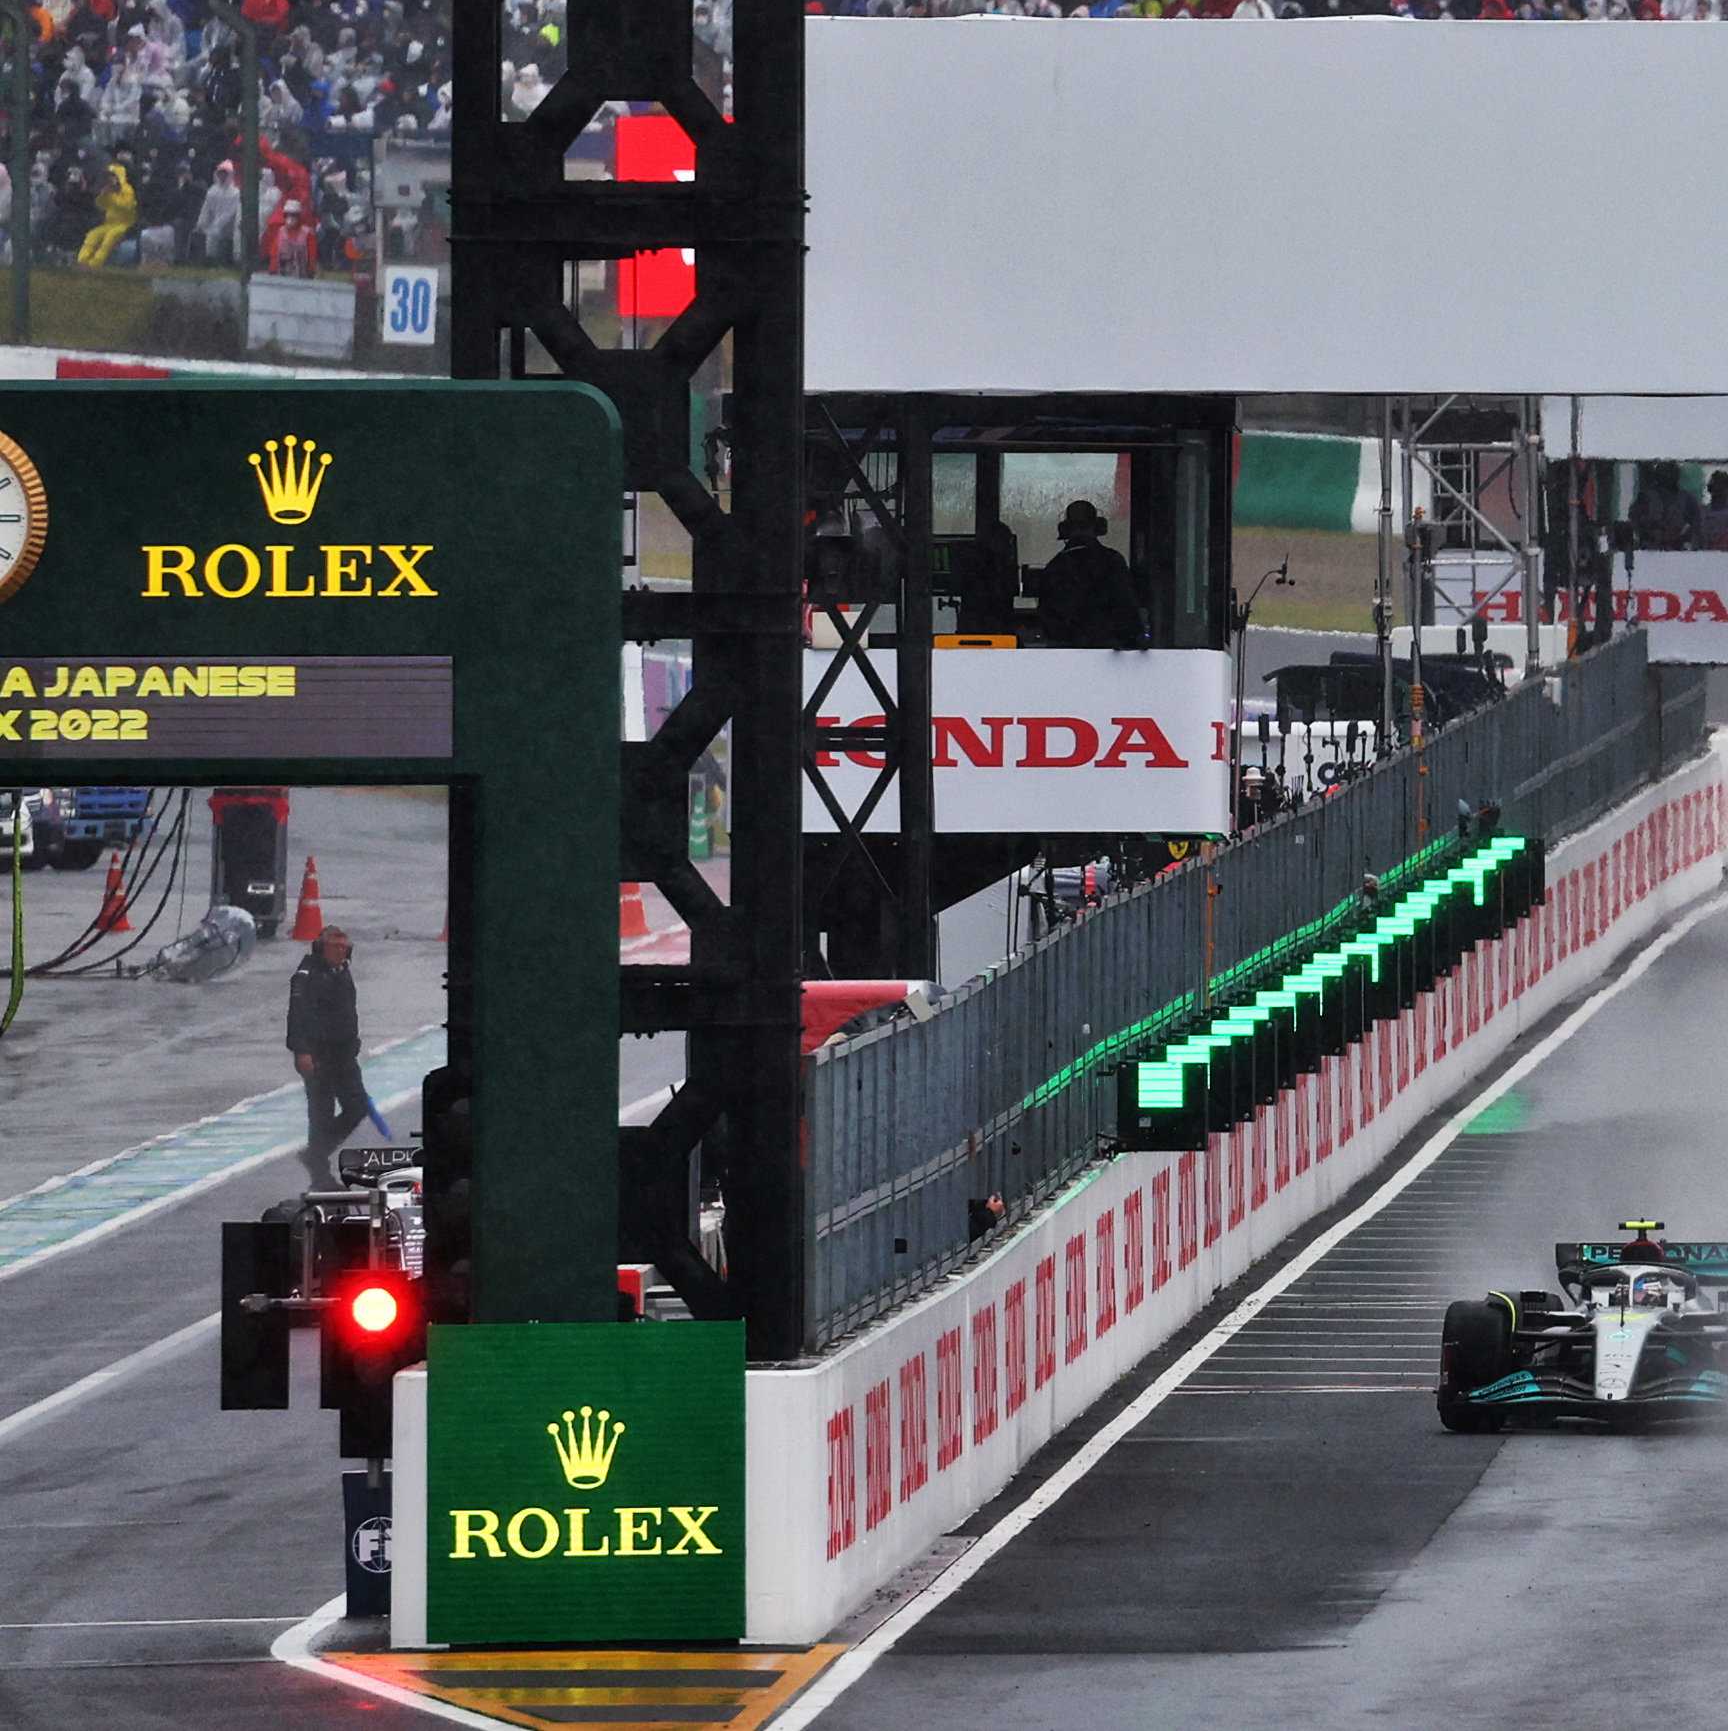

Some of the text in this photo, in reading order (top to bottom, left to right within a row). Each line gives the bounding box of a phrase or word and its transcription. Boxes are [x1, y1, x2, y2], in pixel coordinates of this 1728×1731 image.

[389, 276, 431, 334] 30
[141, 544, 438, 599] ROLEX
[44, 666, 296, 698] JAPANESE
[29, 709, 149, 741] 2022
[448, 1505, 723, 1559] ROLEX
